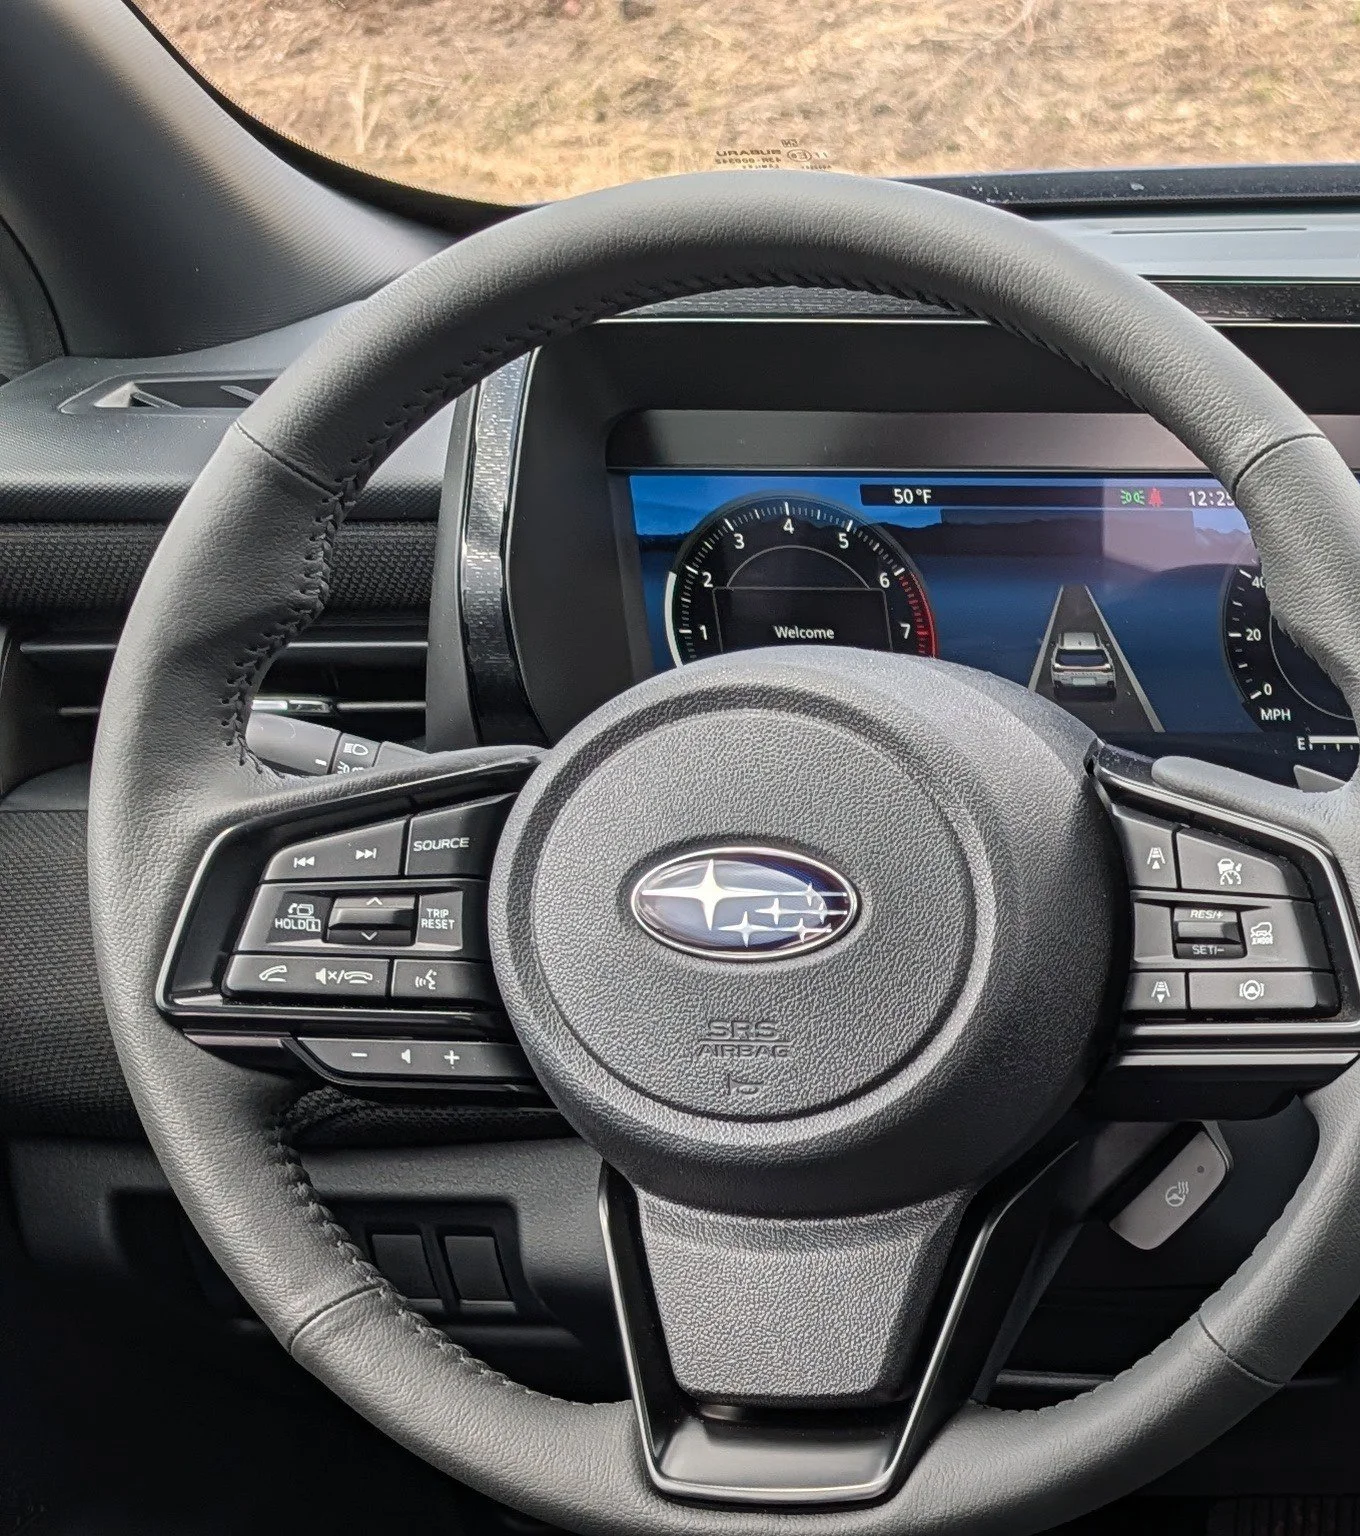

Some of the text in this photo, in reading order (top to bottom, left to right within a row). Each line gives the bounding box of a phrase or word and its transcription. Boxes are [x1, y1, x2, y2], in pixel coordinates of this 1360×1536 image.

[1189, 491, 1235, 507] 12:25
[783, 519, 794, 534] 4
[734, 534, 745, 549] 3
[839, 534, 849, 549] 5
[702, 572, 714, 588] 2
[879, 573, 890, 588] 6
[700, 626, 708, 640] 1
[774, 625, 835, 639] Welcome
[901, 624, 911, 639] 7
[1246, 629, 1261, 641] 20
[1263, 683, 1272, 696] 0
[1261, 708, 1291, 721] MPH
[1298, 737, 1306, 751] E
[413, 837, 470, 851] SOURCE
[426, 908, 449, 918] TRIP
[275, 918, 307, 930] HOLD
[421, 918, 455, 929] RESET
[706, 1020, 779, 1038] SRS
[700, 1044, 793, 1059] AIRBAG
